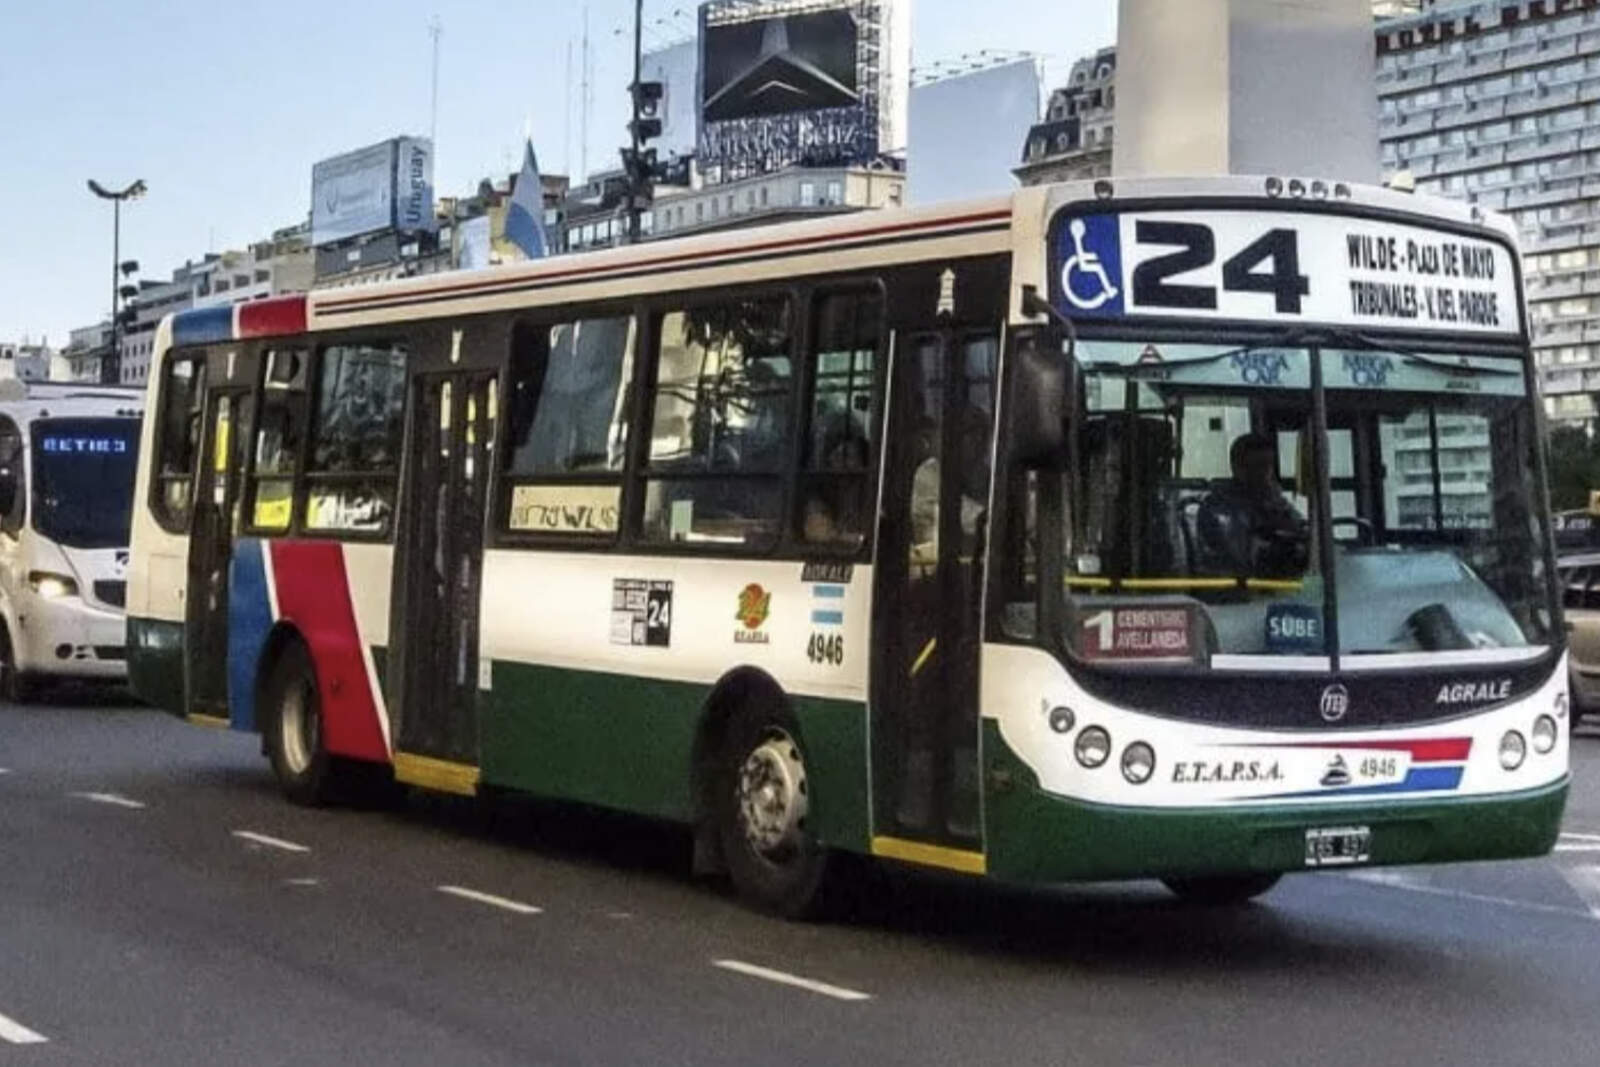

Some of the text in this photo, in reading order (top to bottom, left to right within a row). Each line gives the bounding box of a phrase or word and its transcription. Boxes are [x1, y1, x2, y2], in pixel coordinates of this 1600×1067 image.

[405, 146, 427, 222] Uruguay
[1132, 219, 1309, 315] 24
[1347, 234, 1397, 271] WILDE
[1443, 243, 1459, 277] DE
[1461, 245, 1494, 280] MAYO
[1349, 280, 1417, 318] TRIBUNALES
[1437, 287, 1457, 322] DEL
[1459, 289, 1499, 326] PARQUE
[648, 599, 669, 628] 24
[1269, 614, 1318, 638] SUBE
[1084, 609, 1114, 651] 1
[1116, 629, 1188, 649] AVELLANEDA
[807, 631, 843, 666] 4946
[1435, 680, 1512, 704] AGRALE
[1171, 760, 1284, 783] E.T.A.P.S.A.
[1359, 758, 1397, 778] 4946
